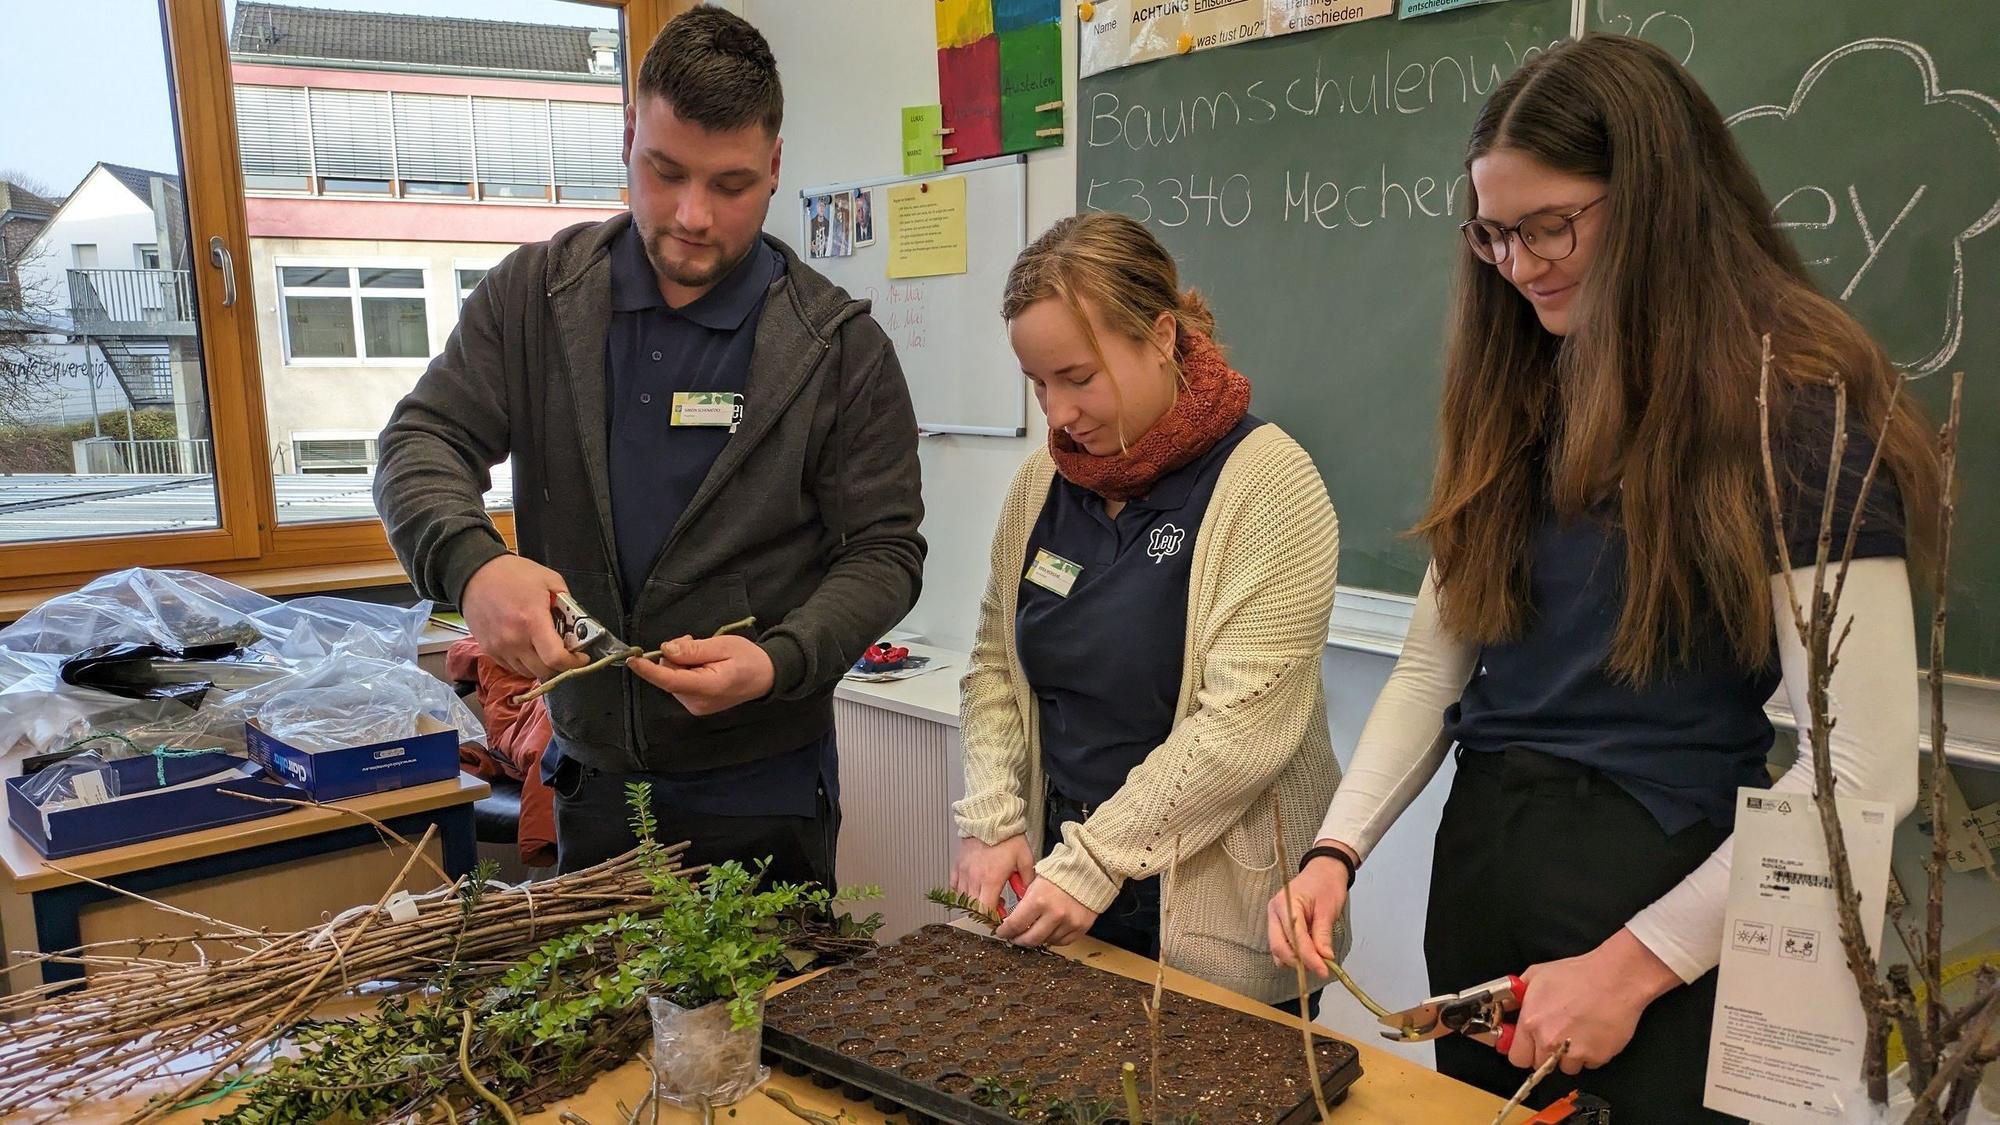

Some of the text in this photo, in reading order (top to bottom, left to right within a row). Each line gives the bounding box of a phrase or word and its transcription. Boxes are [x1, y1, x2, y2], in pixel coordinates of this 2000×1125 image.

[1132, 0, 1189, 24] ACHTUNG
[1289, 6, 1364, 30] entschieden
[1094, 18, 1117, 36] Name
[1220, 27, 1237, 43] tust
[1086, 173, 1252, 228] 53340
[1152, 533, 1179, 553] Ley
